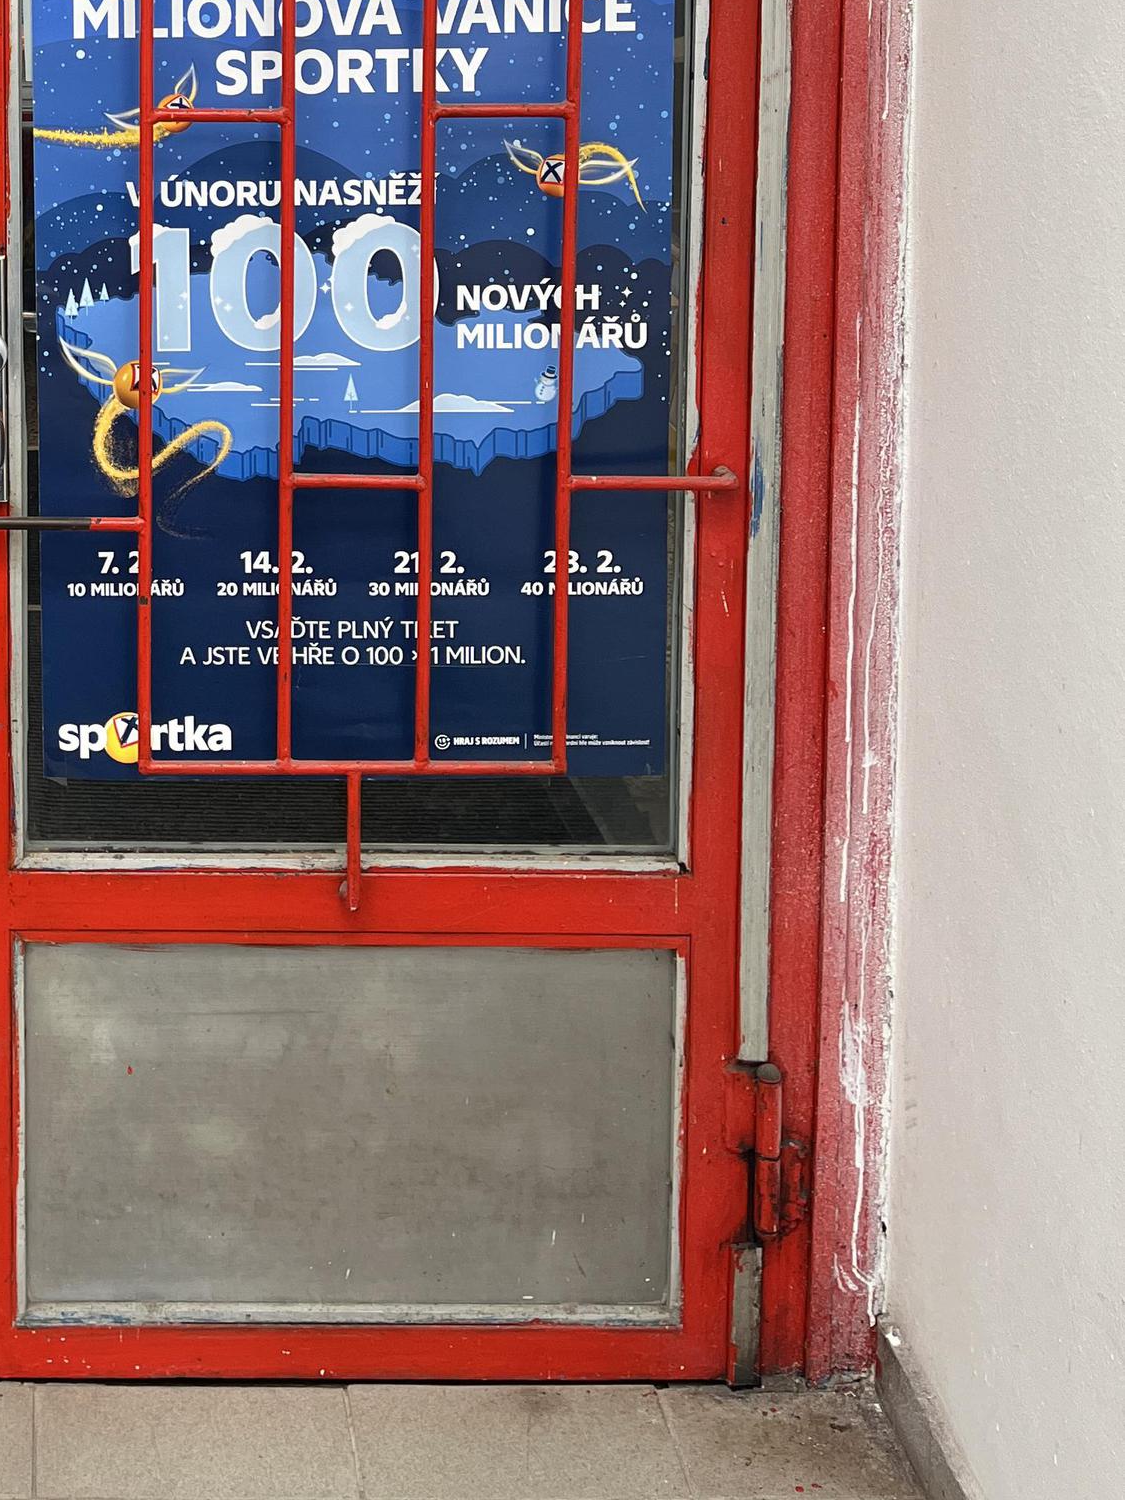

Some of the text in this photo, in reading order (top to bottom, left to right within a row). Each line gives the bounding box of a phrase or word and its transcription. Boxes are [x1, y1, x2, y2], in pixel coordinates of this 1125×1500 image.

[215, 47, 490, 96] SPORTKY
[160, 174, 281, 208] ÚNORU
[128, 212, 440, 352] 100
[97, 550, 120, 574] 7.
[239, 550, 314, 575] 14. 2.
[440, 550, 465, 574] 2.
[596, 549, 622, 574] 2.
[67, 582, 86, 597] 10
[217, 582, 239, 596] 20
[368, 582, 390, 596] 30
[521, 582, 543, 596] 40
[337, 616, 394, 639] PLNÝ
[179, 647, 196, 666] A
[202, 647, 251, 666] JSTE
[291, 642, 335, 666] HŘE
[341, 647, 360, 665] O
[366, 646, 404, 665] 100
[430, 646, 439, 665] 1
[446, 646, 526, 665] MILION.
[453, 736, 520, 745] HRAJ S ROZUMEM
